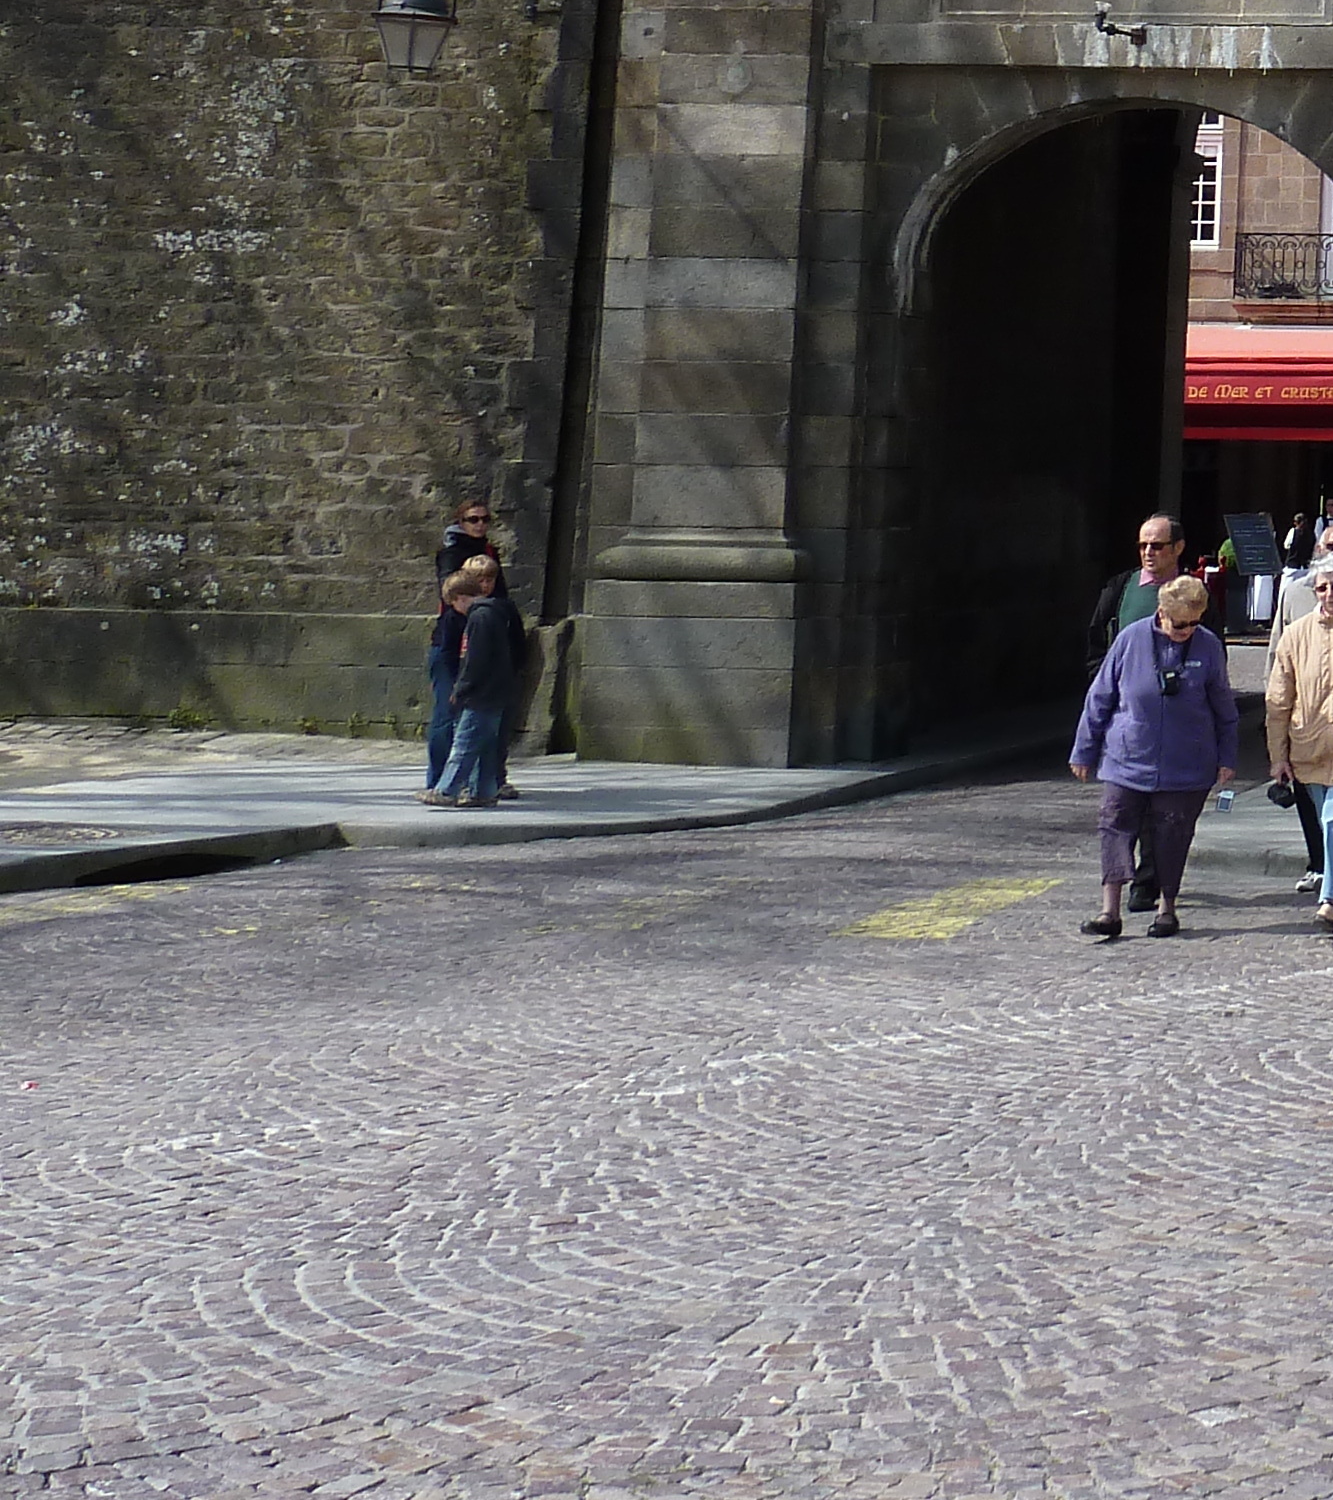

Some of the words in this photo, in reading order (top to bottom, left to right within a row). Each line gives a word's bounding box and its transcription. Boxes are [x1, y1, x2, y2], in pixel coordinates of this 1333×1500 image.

[1188, 386, 1208, 398] DE
[1214, 385, 1248, 398] MER
[1255, 386, 1274, 398] ET
